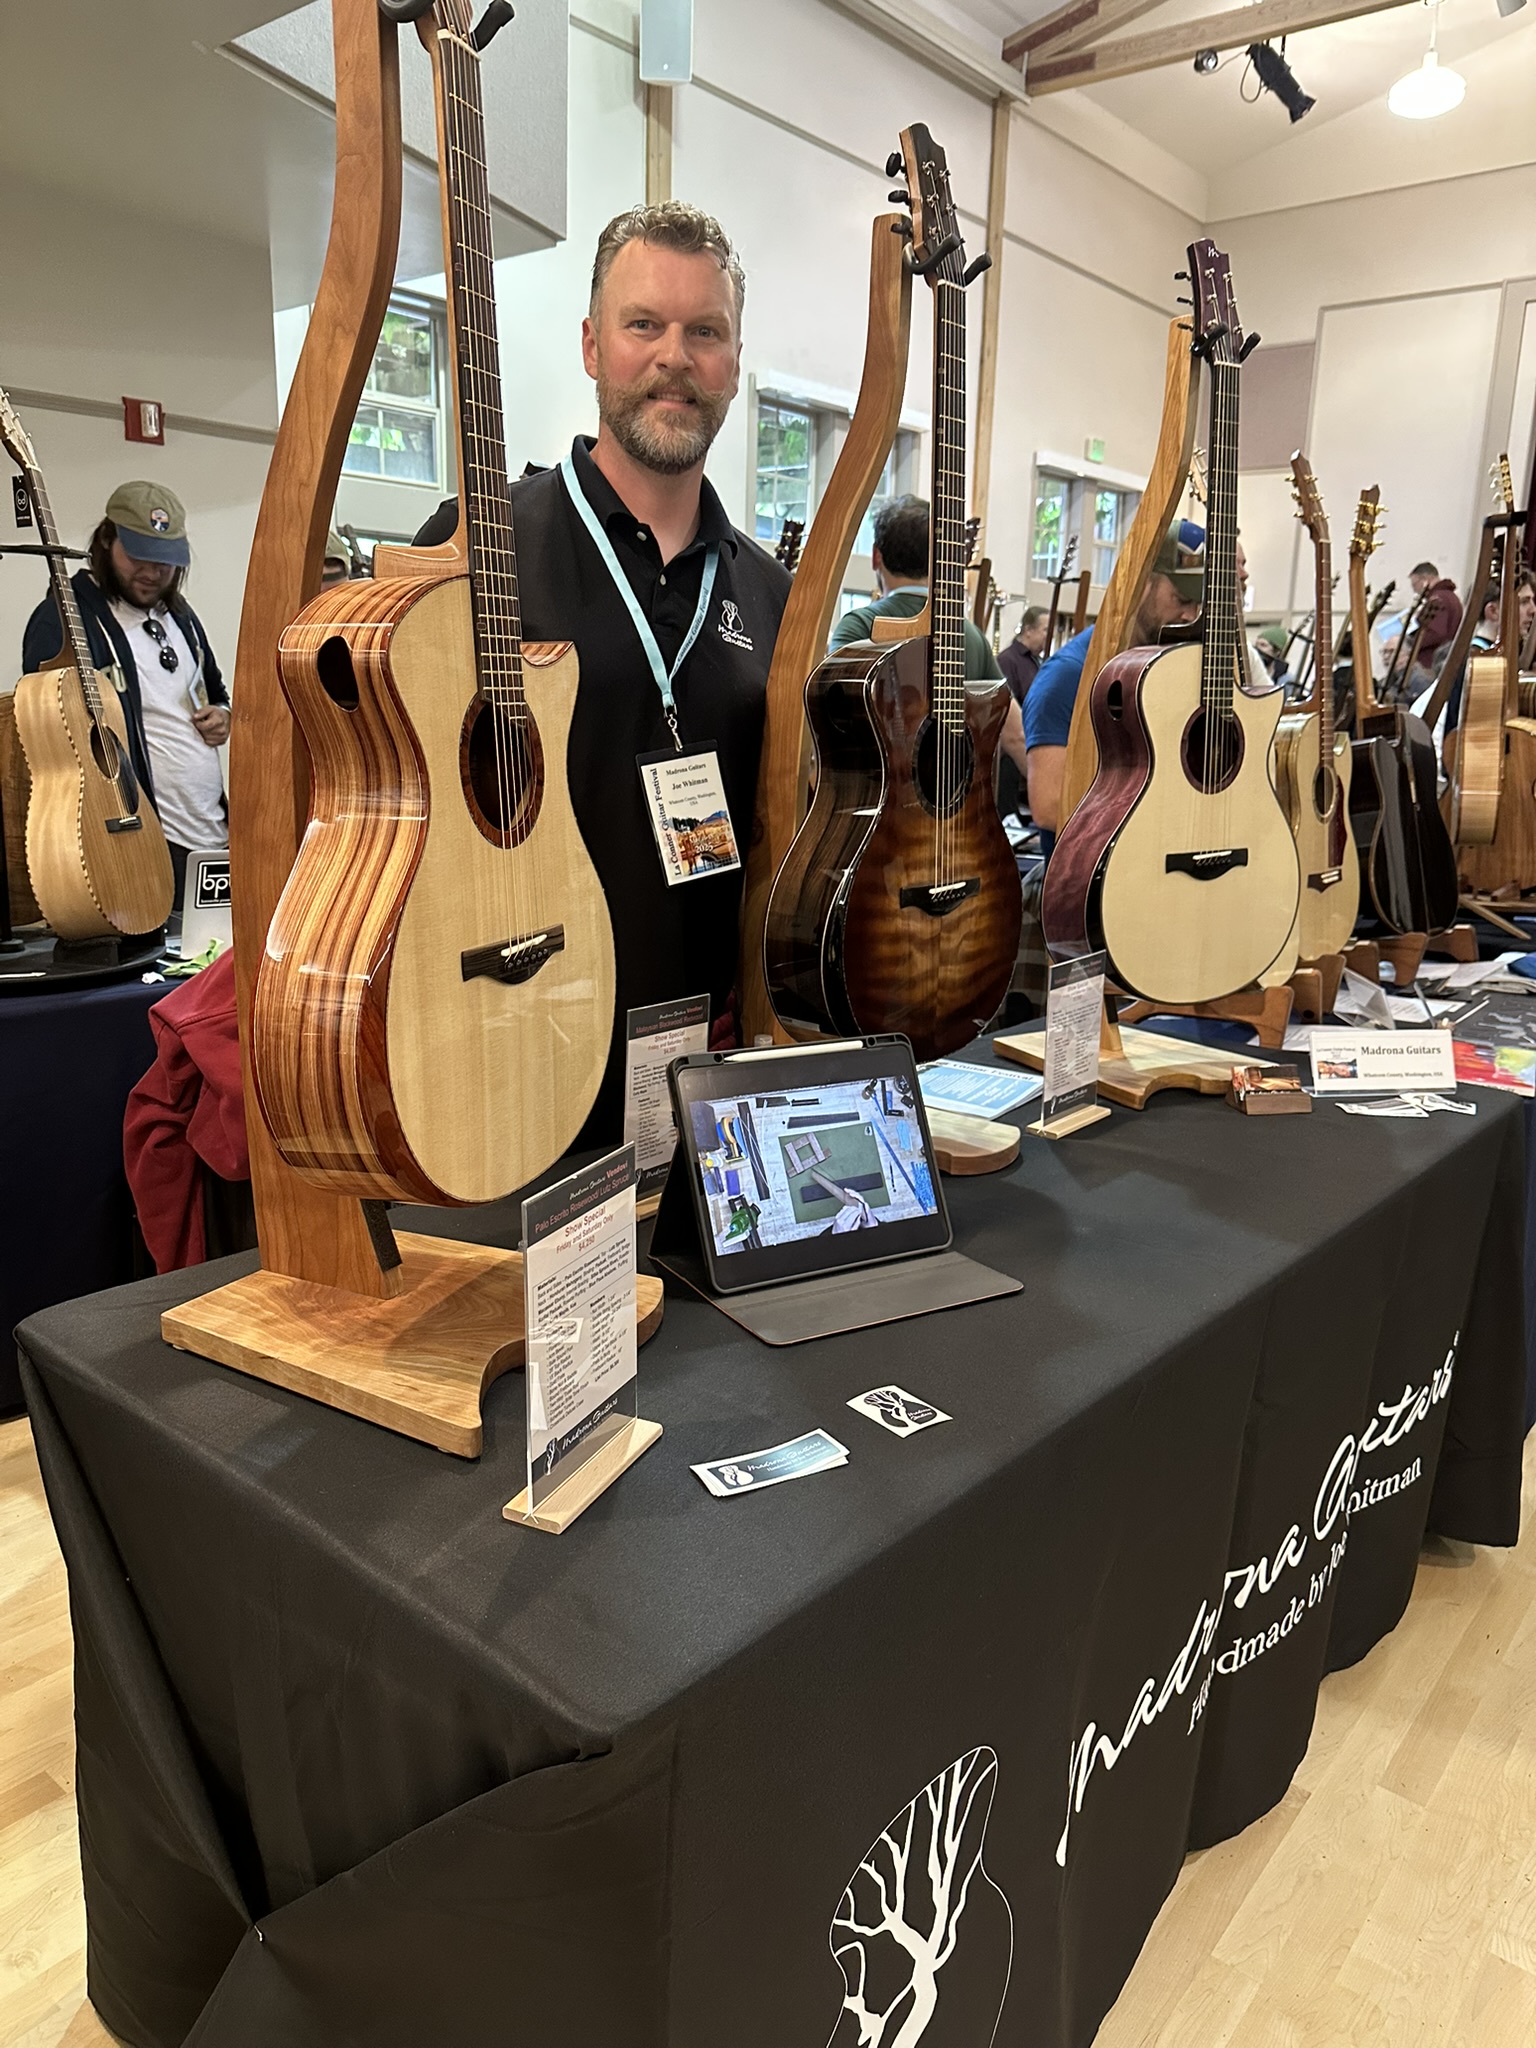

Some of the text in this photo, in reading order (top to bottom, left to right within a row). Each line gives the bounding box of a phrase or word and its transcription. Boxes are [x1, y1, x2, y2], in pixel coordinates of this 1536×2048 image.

[665, 763, 706, 776] Madrona Guitars
[672, 777, 709, 791] Joe Whitman
[650, 768, 682, 876] La Conner Guitar Festival
[202, 866, 231, 899] bp
[1361, 1045, 1405, 1056] Madrona
[1406, 1045, 1442, 1055] Guitars
[606, 1161, 627, 1178] Vendovi
[534, 1220, 549, 1233] Palo
[550, 1208, 569, 1225] Escrito
[599, 1183, 611, 1195] Lutz
[611, 1173, 629, 1188] Spruce
[556, 1213, 613, 1253] Friday and Saturday Only
[564, 1205, 605, 1237] Show Special
[747, 1441, 822, 1472] Madrona Guitars
[1308, 1565, 1329, 1608] by
